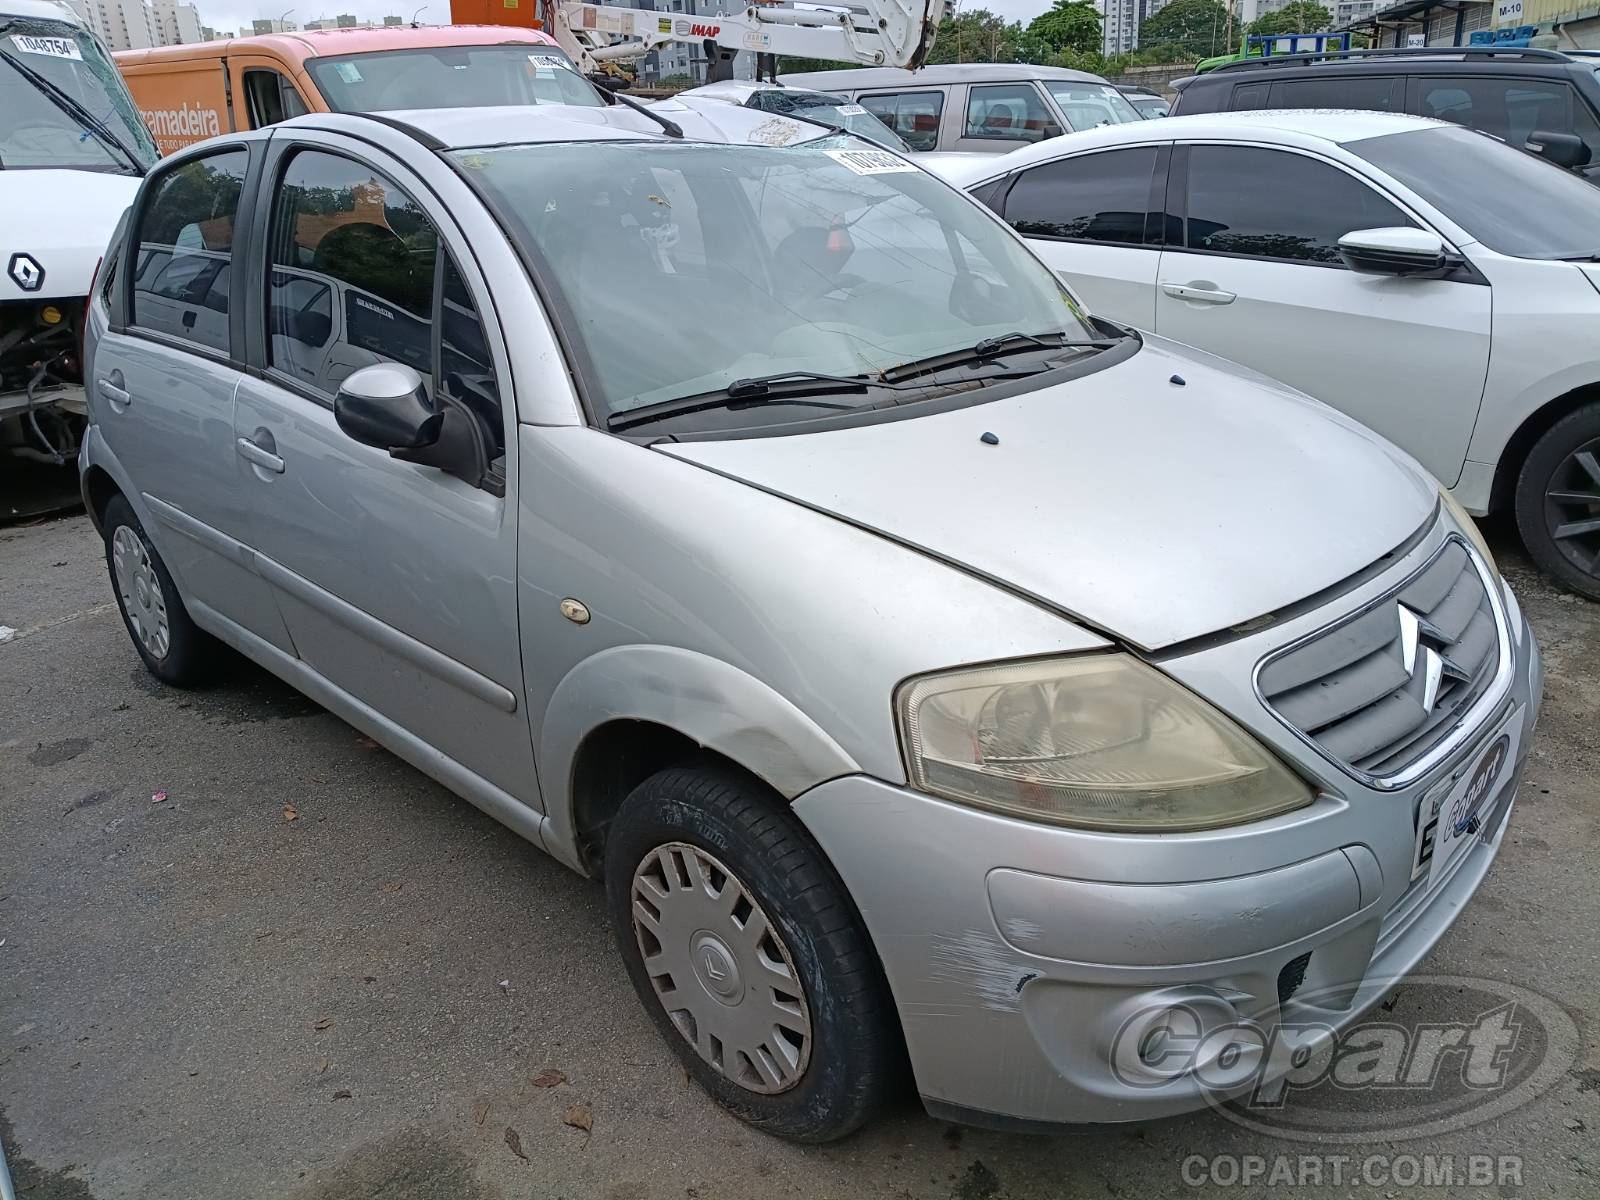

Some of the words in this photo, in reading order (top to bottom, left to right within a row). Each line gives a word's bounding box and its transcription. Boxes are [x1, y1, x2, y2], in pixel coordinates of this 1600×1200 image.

[1499, 3, 1521, 16] M-10
[690, 23, 720, 37] IMAP
[19, 37, 71, 55] 1048754
[1444, 748, 1502, 843] Copart
